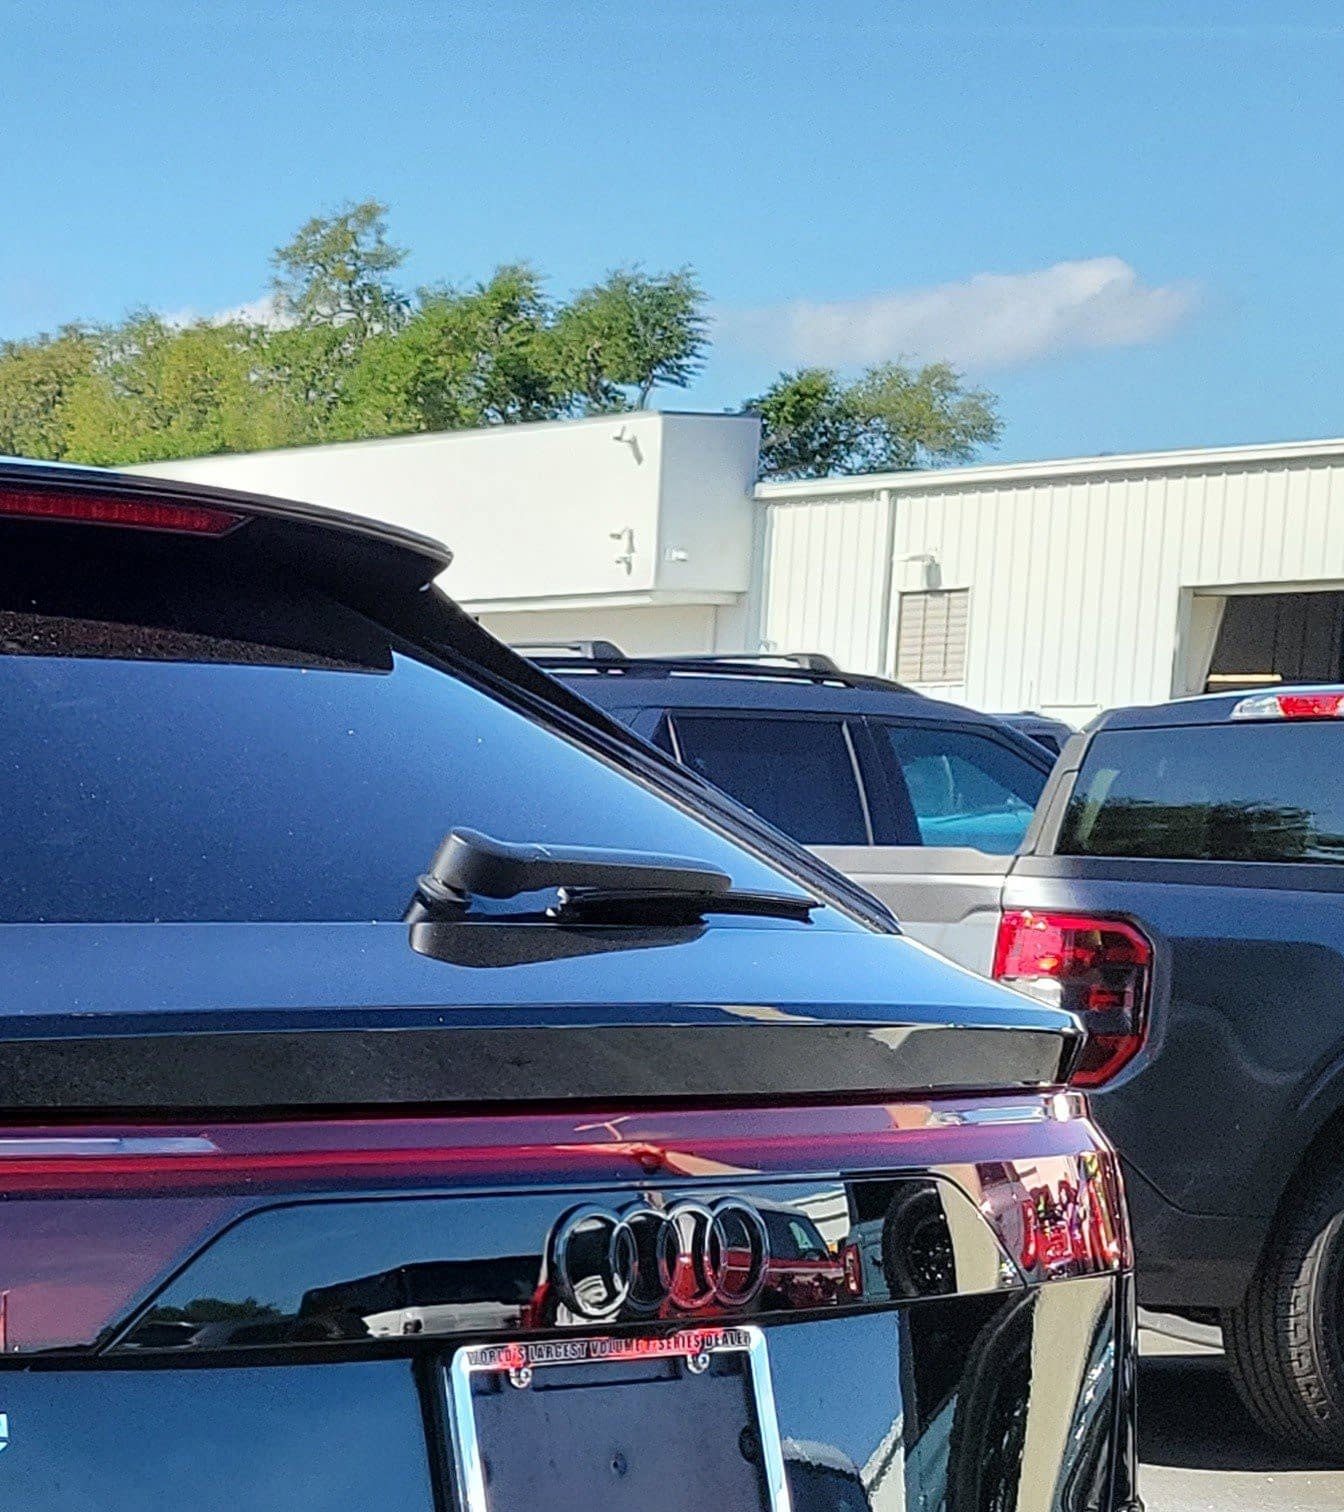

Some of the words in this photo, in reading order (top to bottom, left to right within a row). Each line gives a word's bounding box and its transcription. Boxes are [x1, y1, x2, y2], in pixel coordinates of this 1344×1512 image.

[467, 1345, 526, 1366] WORLD'S
[527, 1341, 588, 1362] LARGEST
[704, 1331, 751, 1348] DEALER
